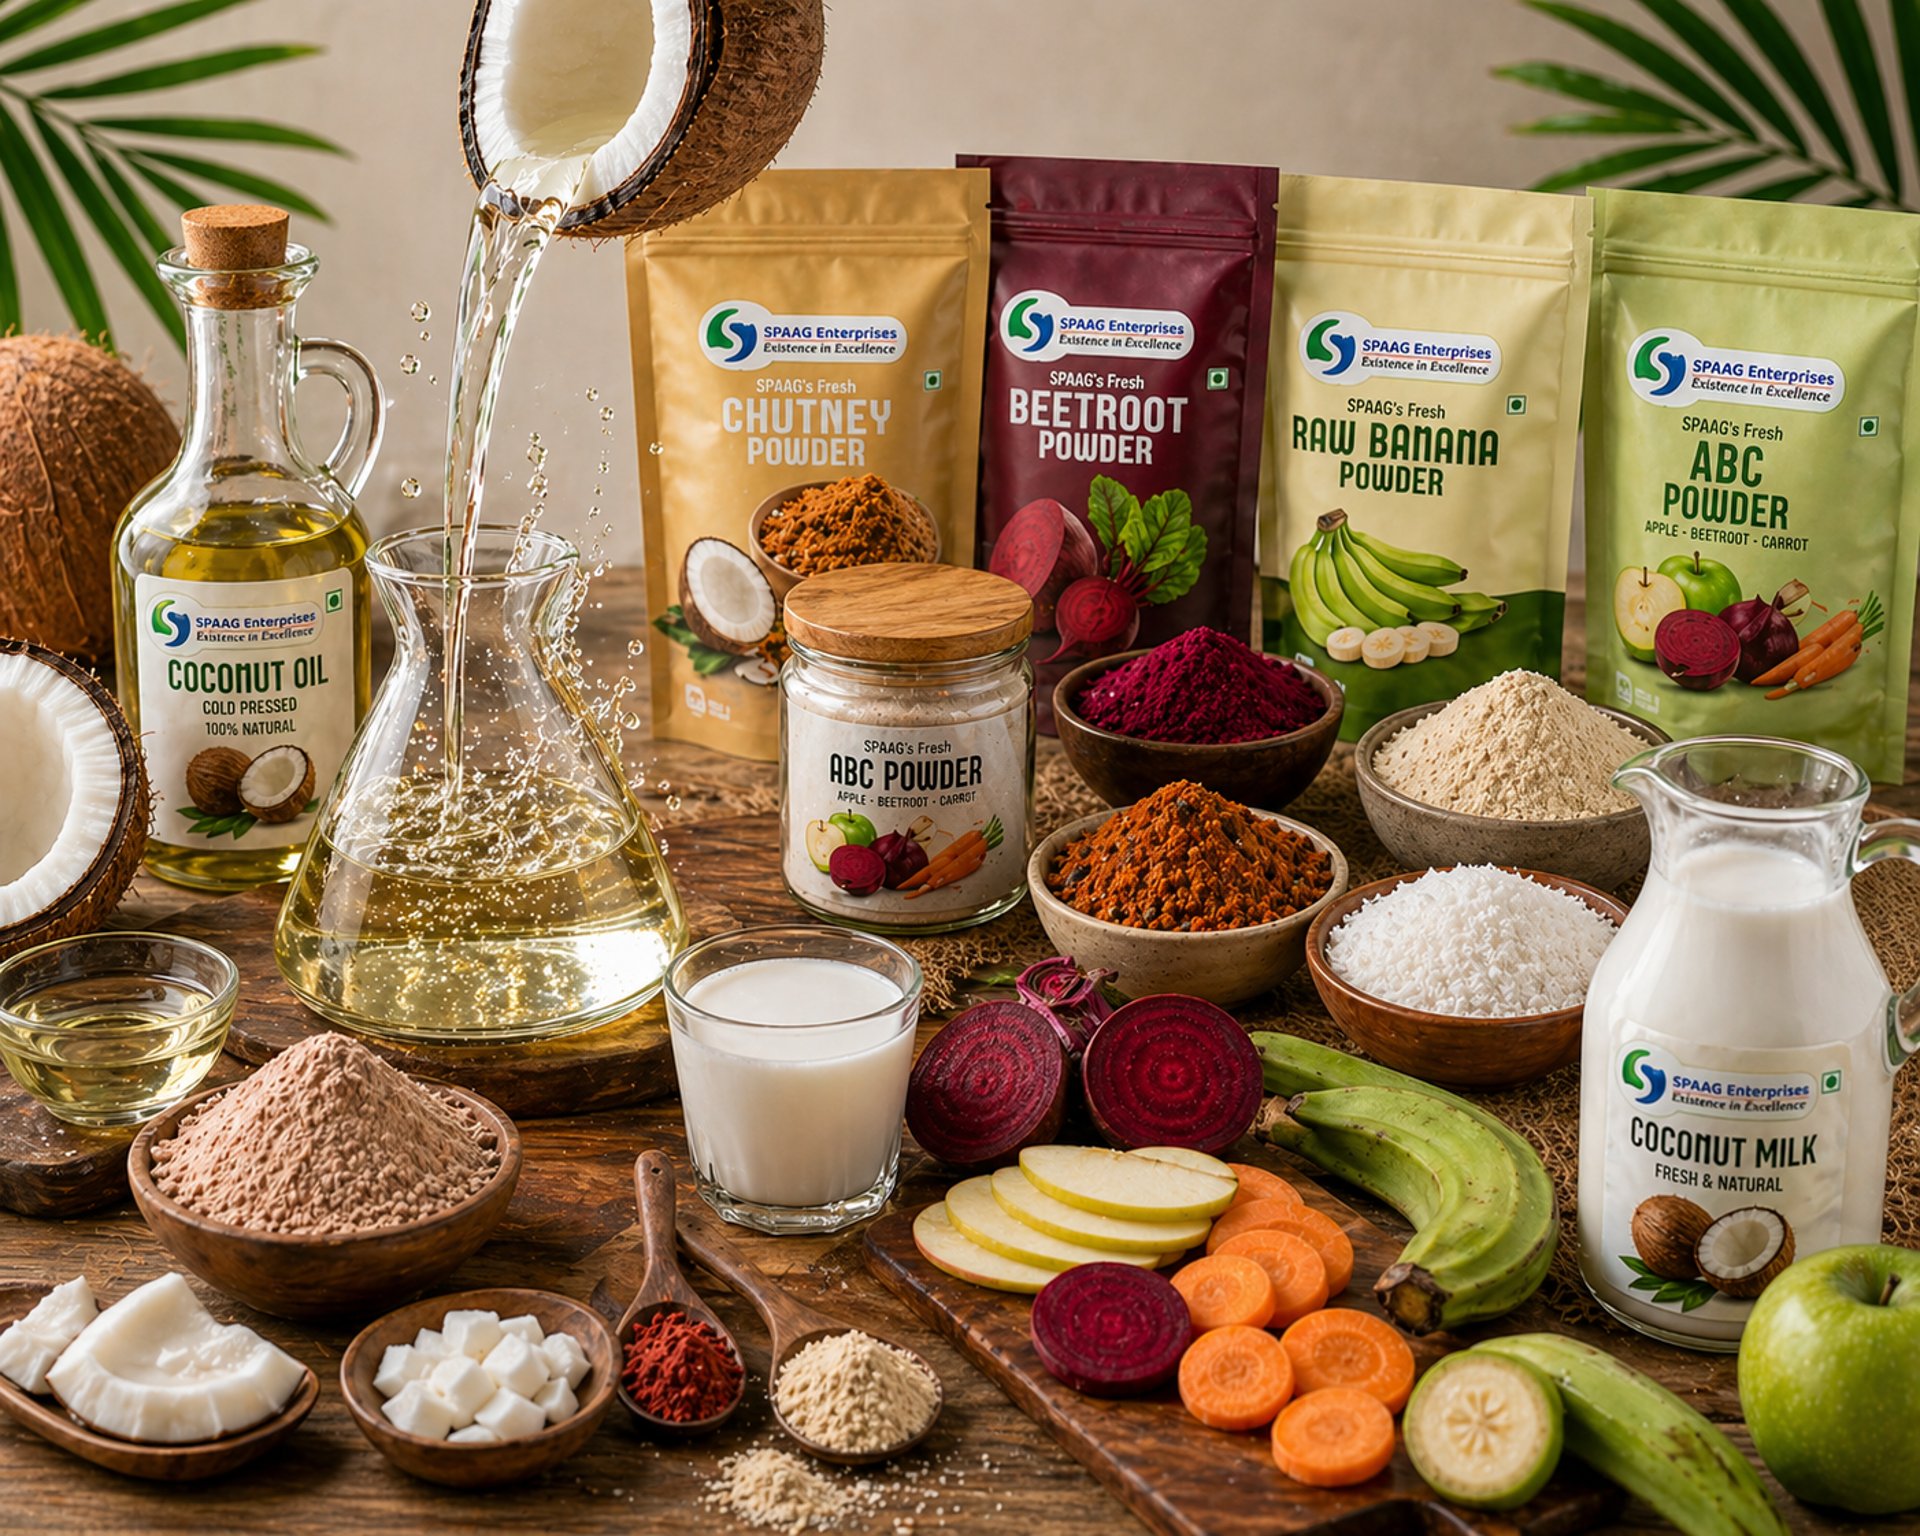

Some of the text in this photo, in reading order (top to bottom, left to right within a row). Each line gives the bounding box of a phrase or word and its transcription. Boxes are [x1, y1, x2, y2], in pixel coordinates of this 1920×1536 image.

[764, 326, 898, 341] SPAAG Enterprises
[1060, 317, 1184, 335] SPAAG Enterprises
[763, 342, 896, 355] Existence in Excellence
[1058, 334, 1182, 351] Existence in Excellence
[1363, 339, 1492, 360] SPAAG Enterprises
[1361, 356, 1489, 375] Existence in Excellence
[1693, 359, 1835, 387] SPAAG Enterprises
[756, 378, 856, 393] SPAAG's Fresh
[1050, 371, 1145, 390] SPAAG's Fresh
[1691, 378, 1831, 403] Existence in Excellence
[722, 397, 891, 435] CHUTNEY
[1009, 388, 1189, 434] BEETROOT
[1347, 398, 1445, 419] SPAAG's Fresh
[1292, 415, 1499, 466] RAW BANANA
[1682, 416, 1783, 441] SPAAG's Fresh
[747, 437, 865, 466] POWDER
[1038, 431, 1153, 464] POWDER
[1689, 440, 1764, 487] ABC
[1340, 461, 1444, 495] POWDER
[1663, 482, 1788, 530] POWDER
[1645, 521, 1678, 538] APPLE
[1690, 527, 1749, 545] BEETROOT
[1762, 535, 1809, 551] CARROT
[196, 612, 316, 629] SPAAG Enterprises
[168, 654, 328, 694] COCONUT OIL
[203, 697, 297, 715] COLD PRESSED
[206, 719, 296, 736] 100% NATURAL
[864, 740, 951, 755] SPAAG's Fresh
[830, 753, 982, 791] ABC POWDER
[837, 791, 866, 805] APPLE
[878, 797, 928, 808] BEETROOT
[940, 792, 976, 805] CARROT
[1673, 1076, 1809, 1100] SPAAG Enterprises
[1672, 1092, 1806, 1112] Existence in Excellence
[1631, 1116, 1818, 1168] COCONUT MILK
[1655, 1163, 1782, 1192] FRESH & NATURAL
